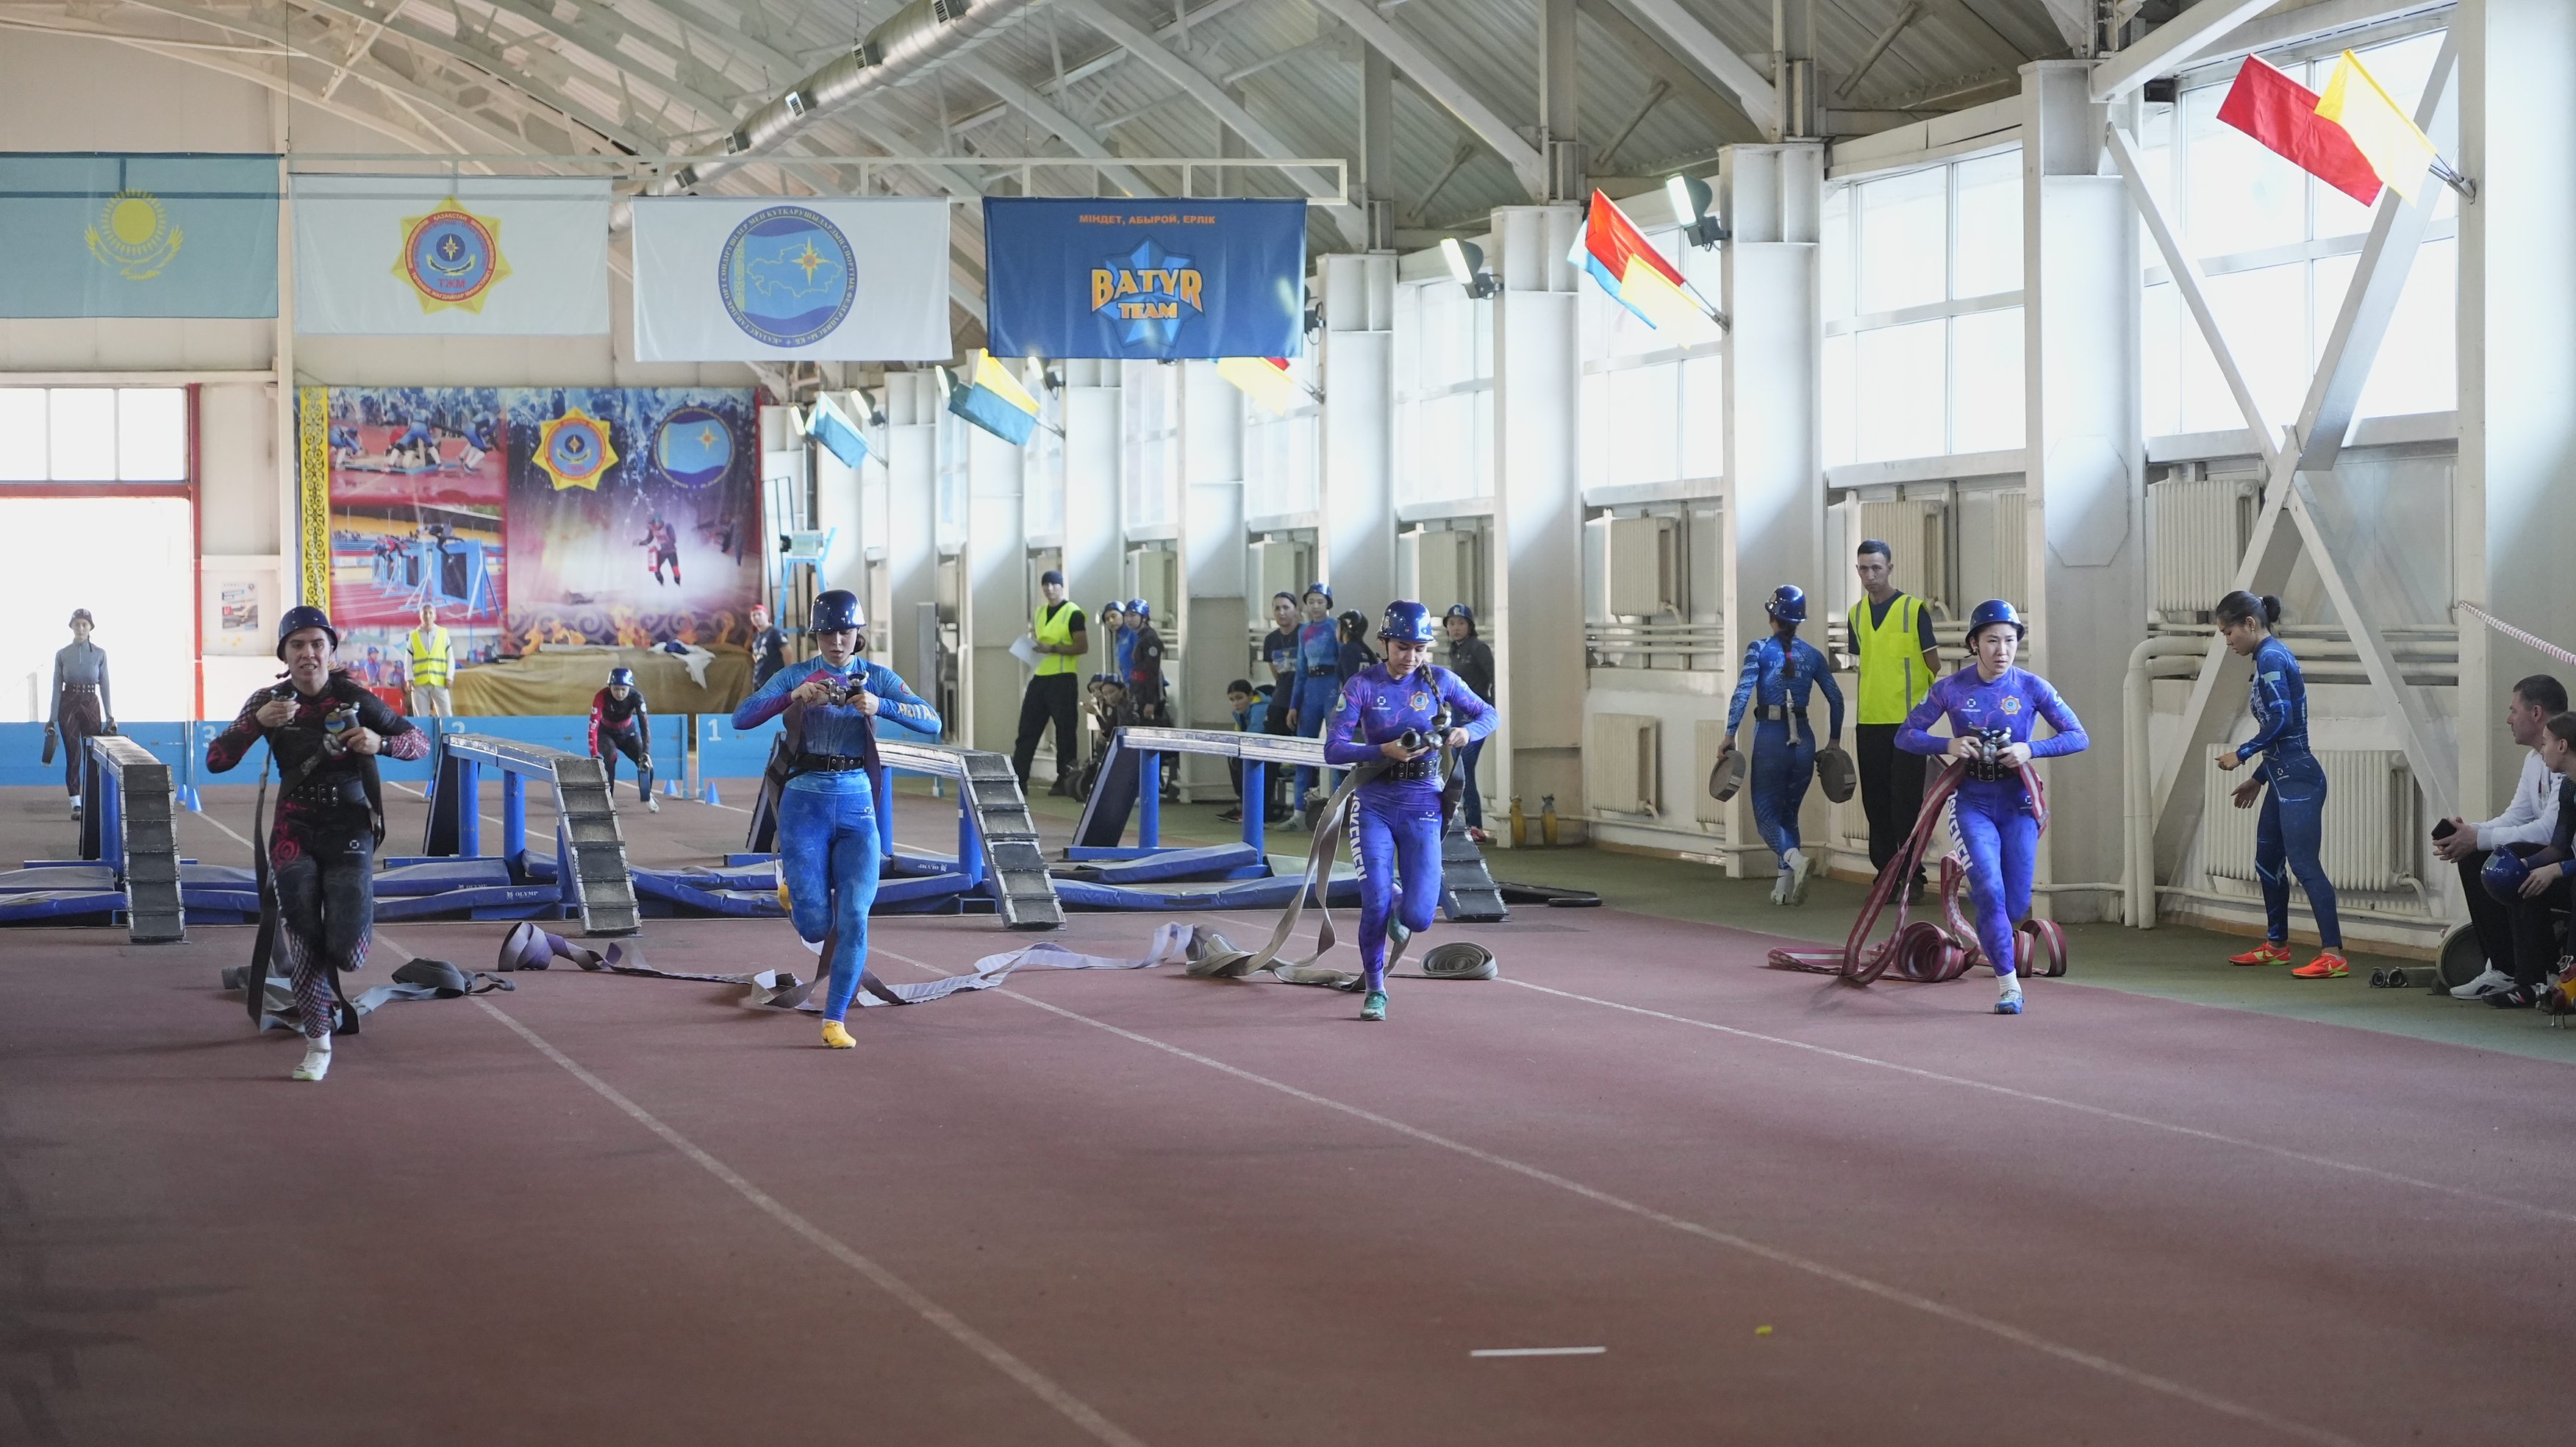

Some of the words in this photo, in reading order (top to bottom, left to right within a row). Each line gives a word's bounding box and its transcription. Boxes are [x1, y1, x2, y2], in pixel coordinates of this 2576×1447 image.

[1079, 215, 1126, 225] МІНДЕТ,
[1128, 214, 1180, 224] АБЫРОЙ,
[1183, 215, 1215, 224] ЕРЛІК
[438, 279, 466, 288] ТЖМ
[1092, 269, 1204, 312] BATYR
[1117, 302, 1178, 319] TEAM
[708, 718, 722, 741] 1
[1349, 795, 1367, 882] SKEMEN
